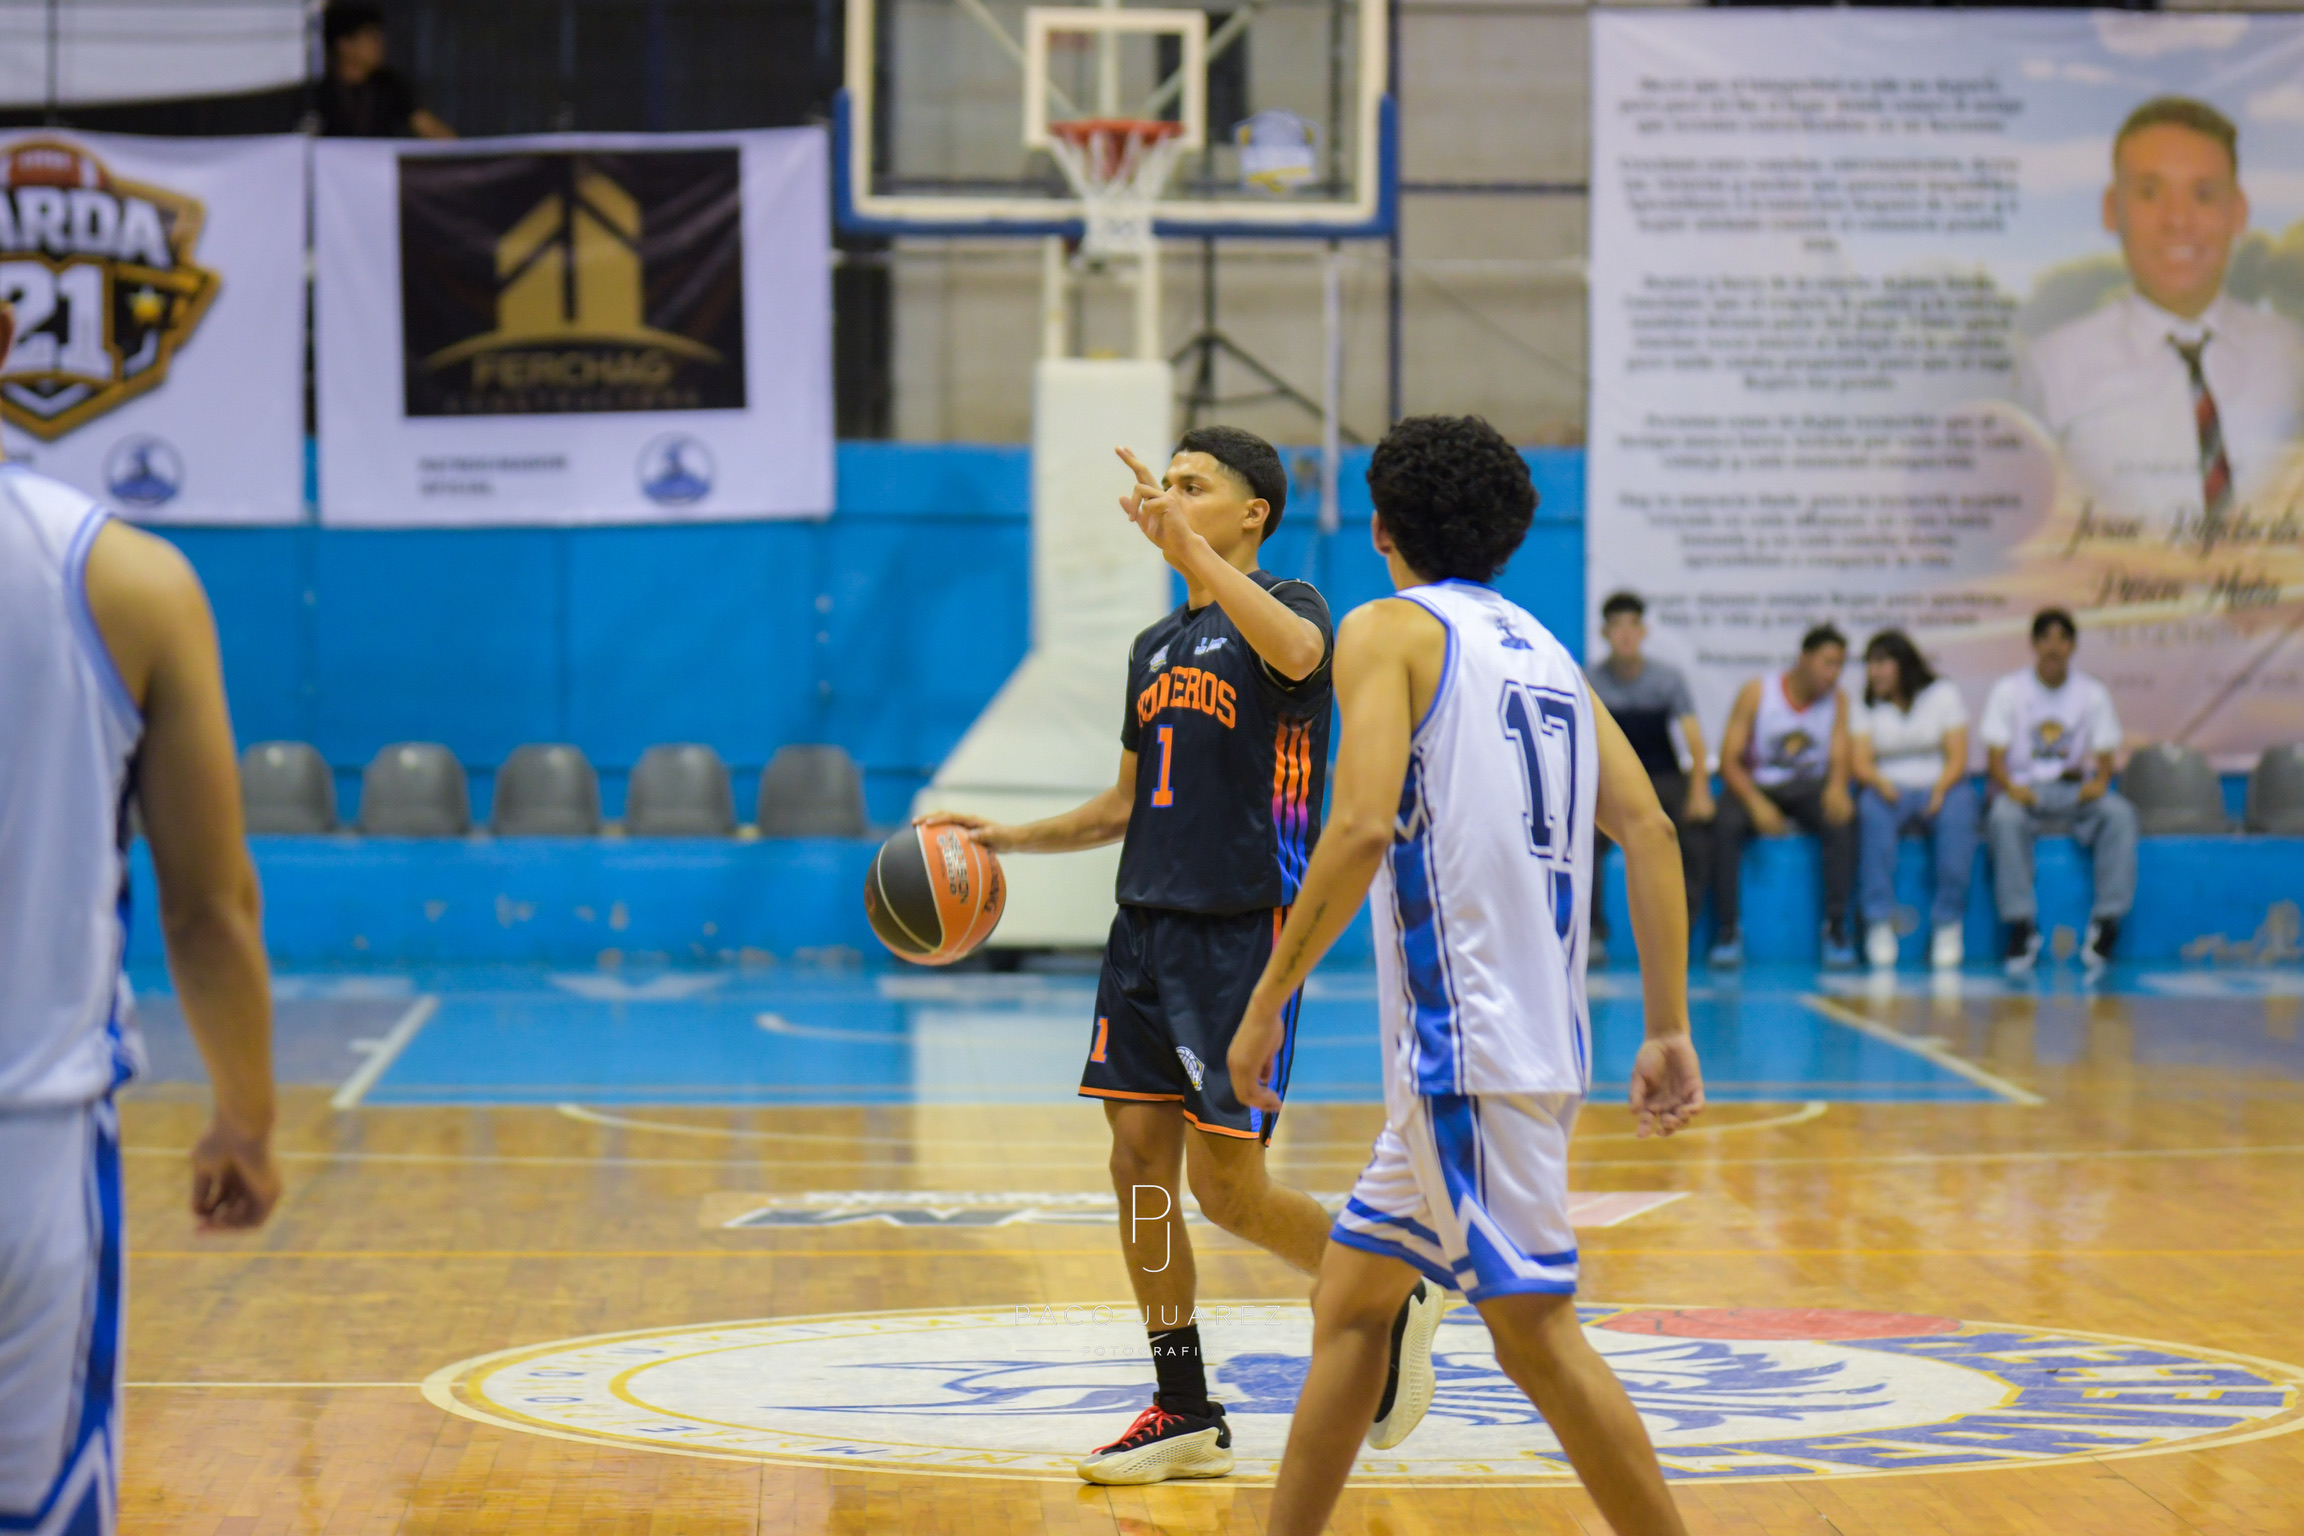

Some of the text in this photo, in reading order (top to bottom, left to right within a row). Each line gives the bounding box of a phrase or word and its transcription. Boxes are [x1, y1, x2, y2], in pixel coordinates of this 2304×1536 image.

[0, 185, 174, 271] RDA
[0, 262, 115, 380] 21
[1151, 724, 1174, 808] 1
[1498, 678, 1577, 863] 17
[1090, 1015, 1108, 1063] 1
